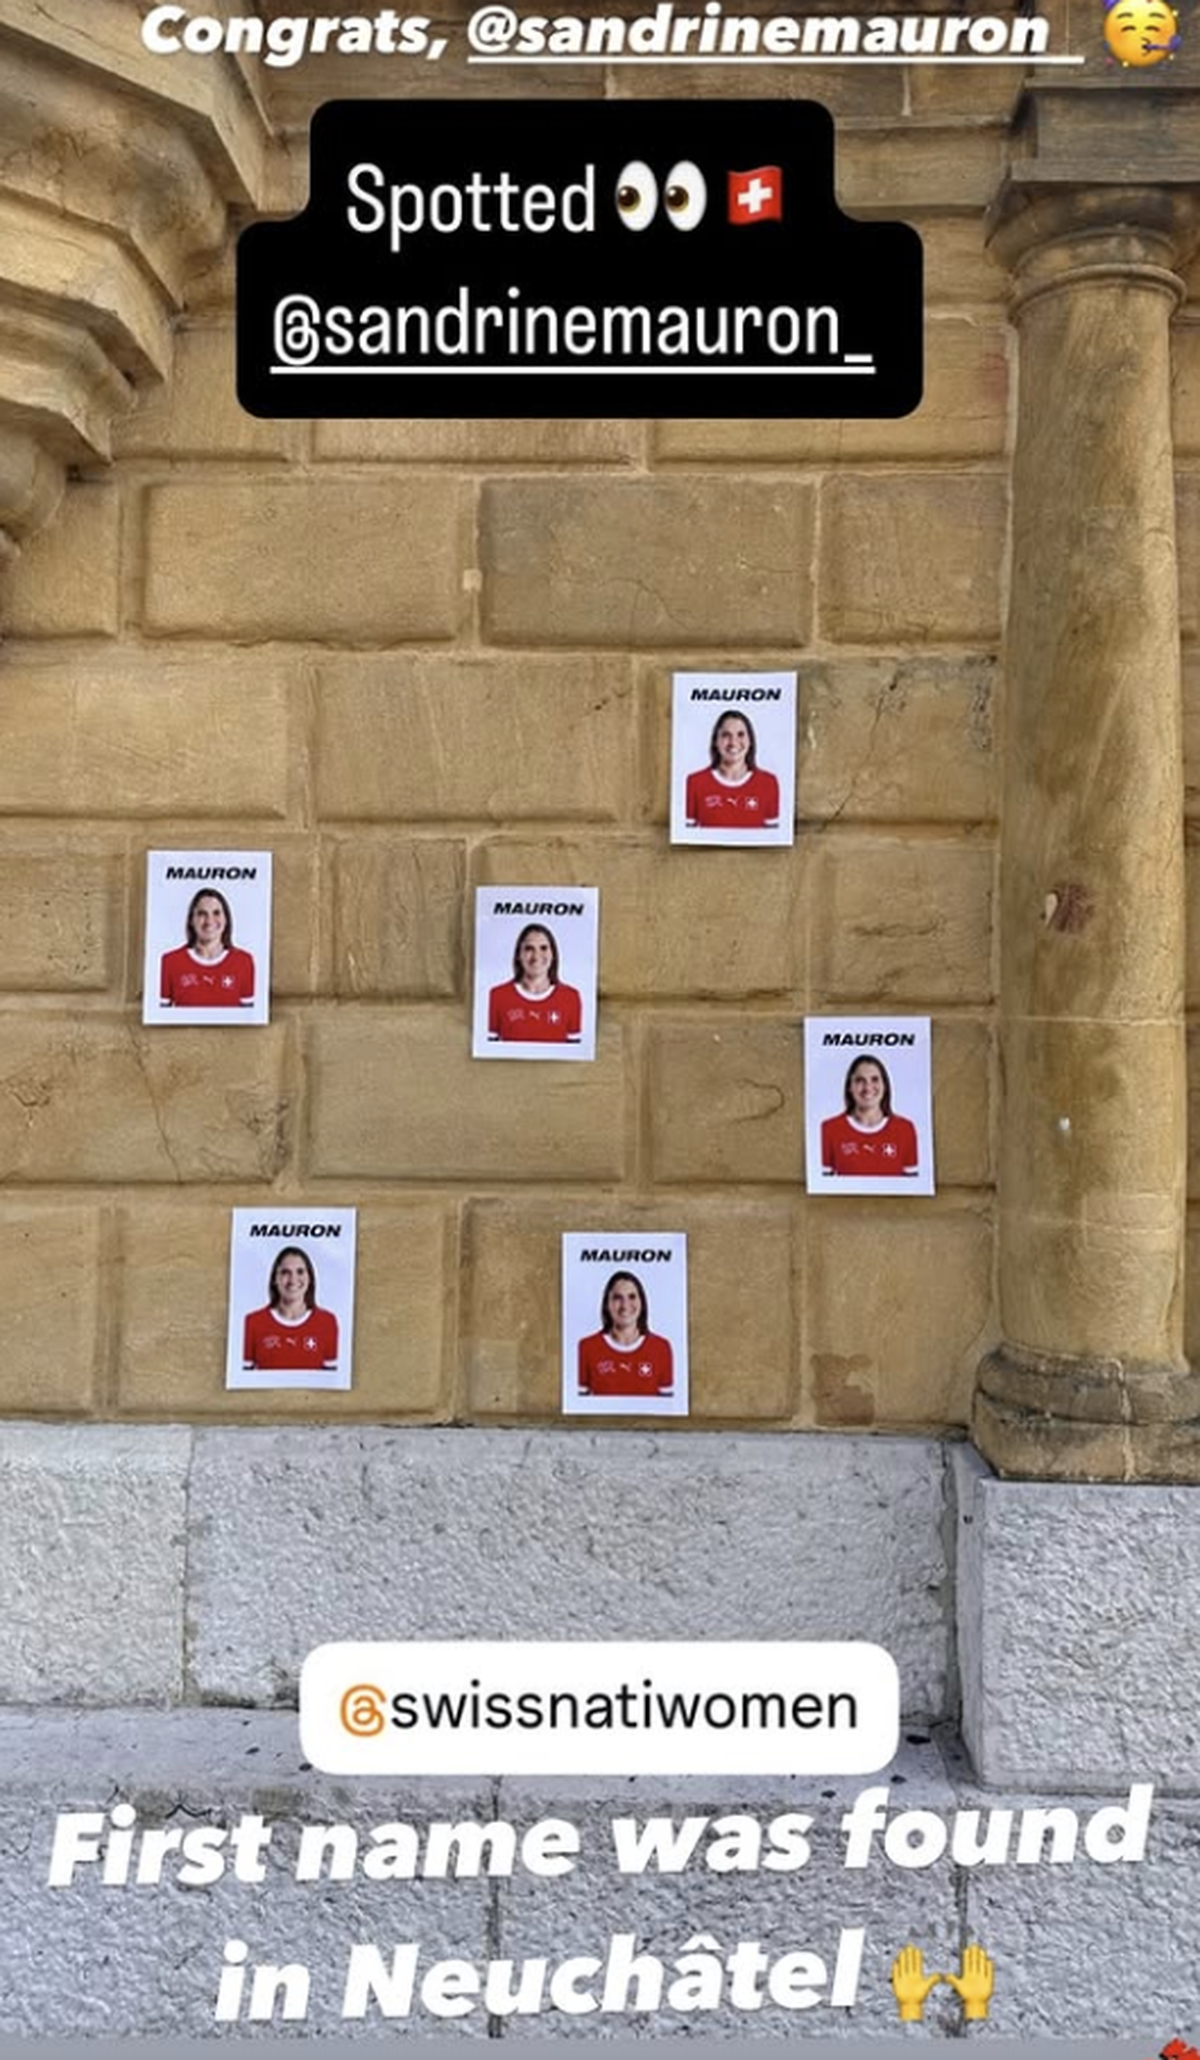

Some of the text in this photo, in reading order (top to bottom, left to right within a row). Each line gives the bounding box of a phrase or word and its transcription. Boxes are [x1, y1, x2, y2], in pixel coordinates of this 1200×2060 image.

[690, 688, 782, 702] MAURON
[166, 866, 257, 880] MAURON
[493, 902, 584, 916] MAURON
[822, 1032, 916, 1047] MAURON
[249, 1224, 342, 1238] MAURON
[580, 1249, 672, 1263] MAURON
